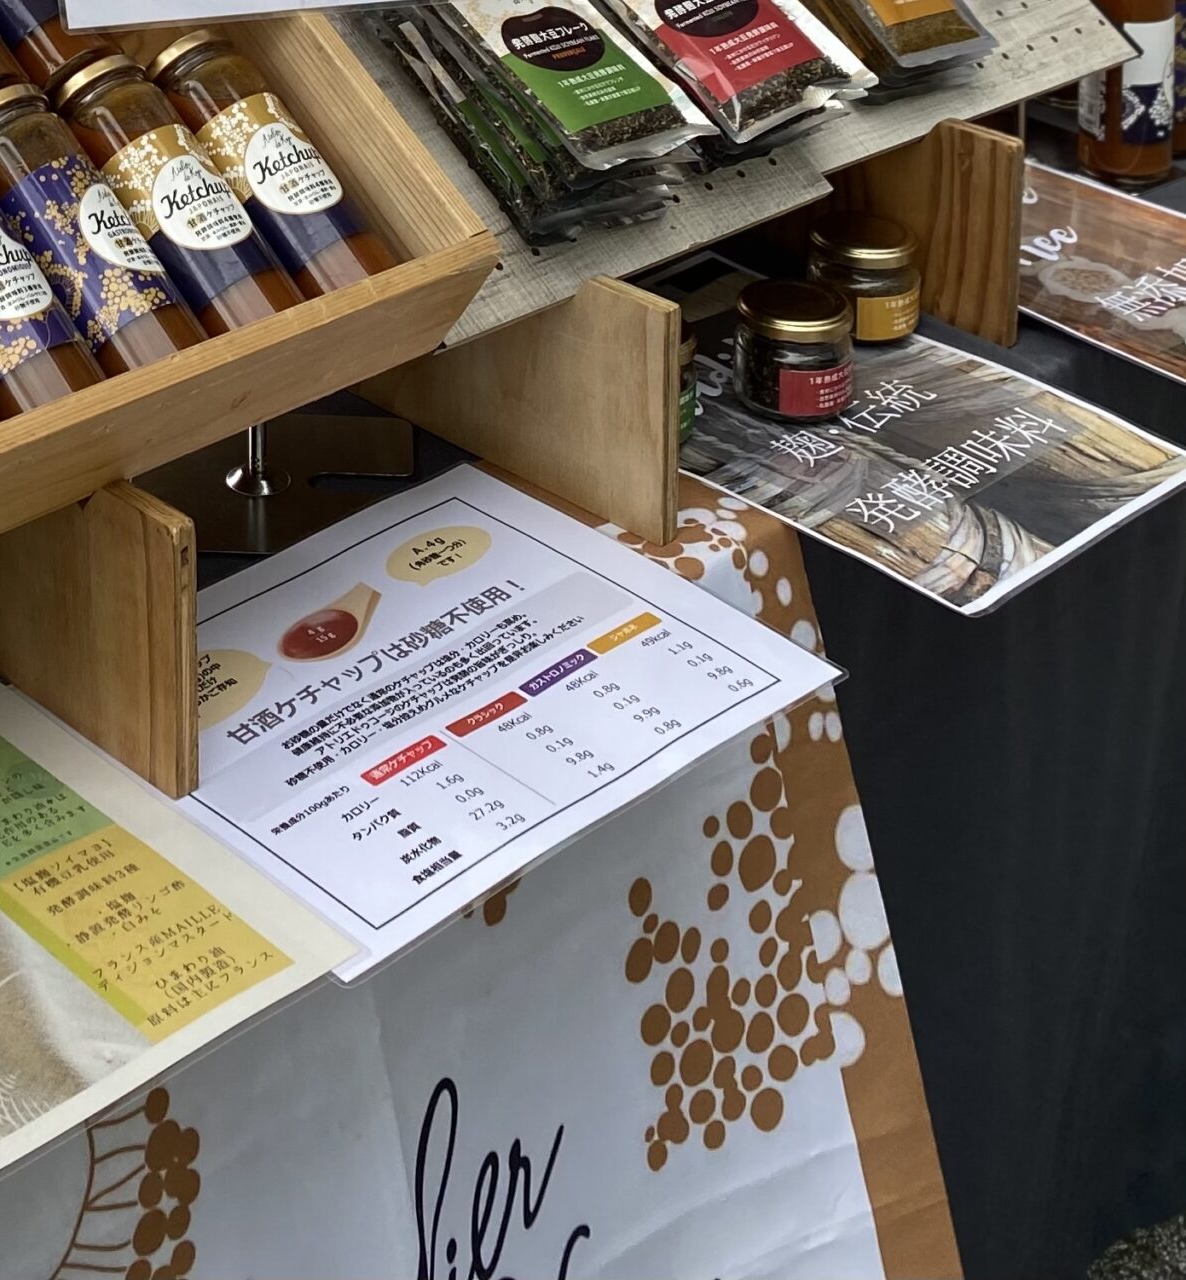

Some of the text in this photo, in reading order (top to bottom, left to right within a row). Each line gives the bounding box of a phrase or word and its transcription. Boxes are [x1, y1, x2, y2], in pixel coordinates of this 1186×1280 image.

[846, 407, 1068, 535] 発酵調味料
[341, 629, 672, 823] カロリー 112Kcal 48Kcal 48Kcal 49kcal
[352, 640, 693, 841] タンパク質 1.6g 0.8g 0.8g 1.1g
[455, 786, 484, 804] 0.0g
[546, 736, 574, 753] 0.1g
[614, 694, 640, 711] 0.1g
[687, 652, 713, 669] 0.1g
[467, 702, 504, 726] クラシック
[469, 799, 505, 821] 27.2g
[566, 749, 594, 766] 9.8g
[633, 706, 661, 723] 9.9g
[707, 664, 733, 681] 9.8g
[496, 812, 526, 832] 3.2g
[588, 762, 615, 779] 1.4g
[654, 718, 682, 736] 0.8g
[728, 677, 754, 693] 0.6g
